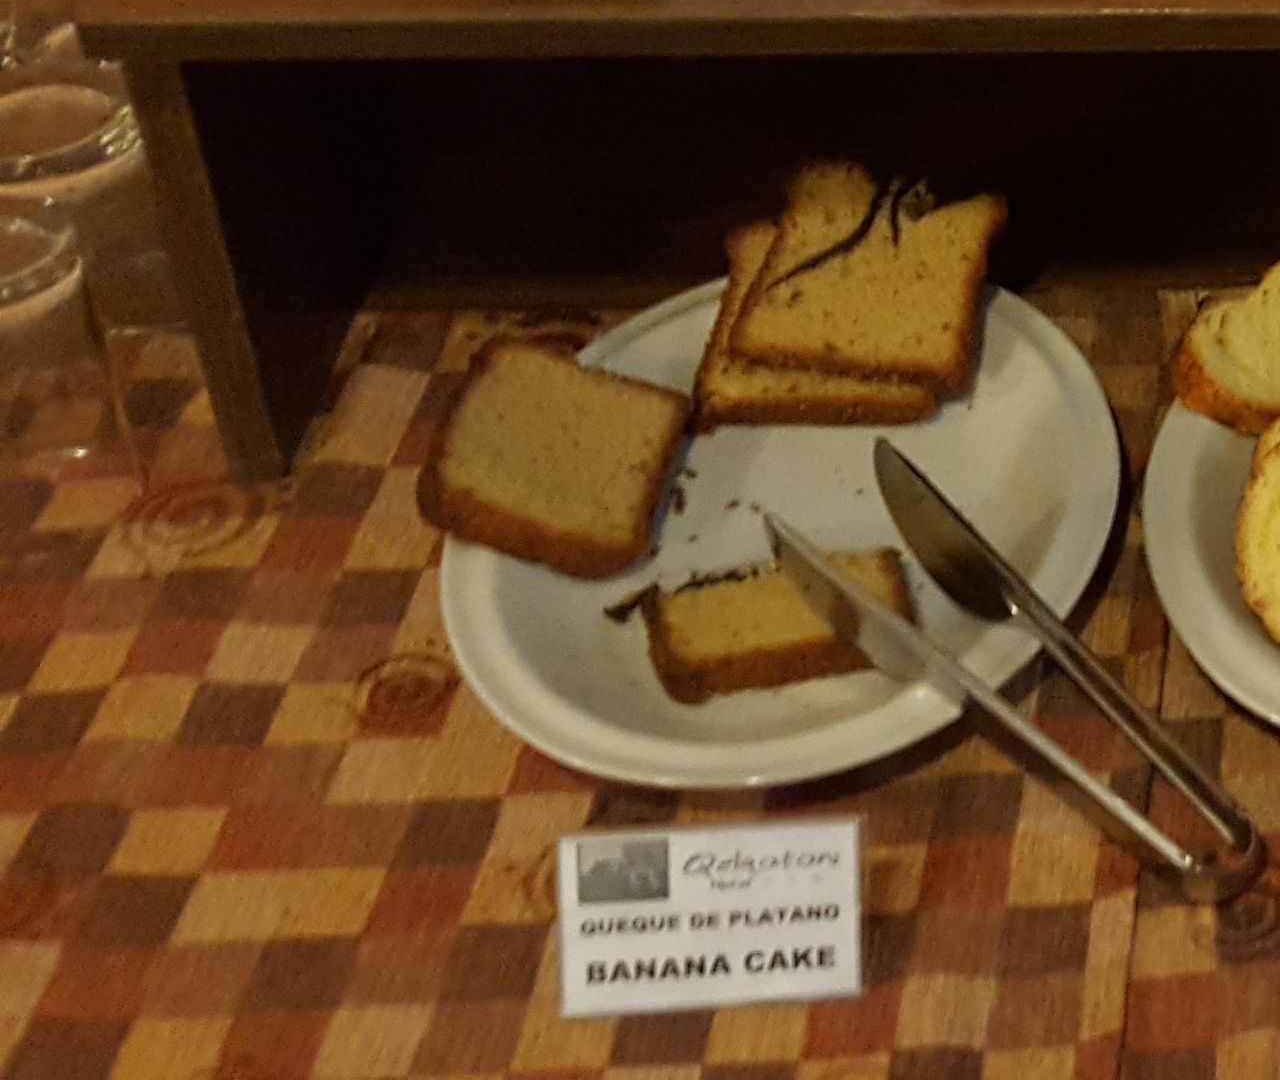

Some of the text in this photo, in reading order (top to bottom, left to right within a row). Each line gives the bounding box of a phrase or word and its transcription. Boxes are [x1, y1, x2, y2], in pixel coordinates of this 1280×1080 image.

[579, 904, 841, 936] QUEQUE DE PLATANO
[585, 945, 835, 985] BANANA CAKE
